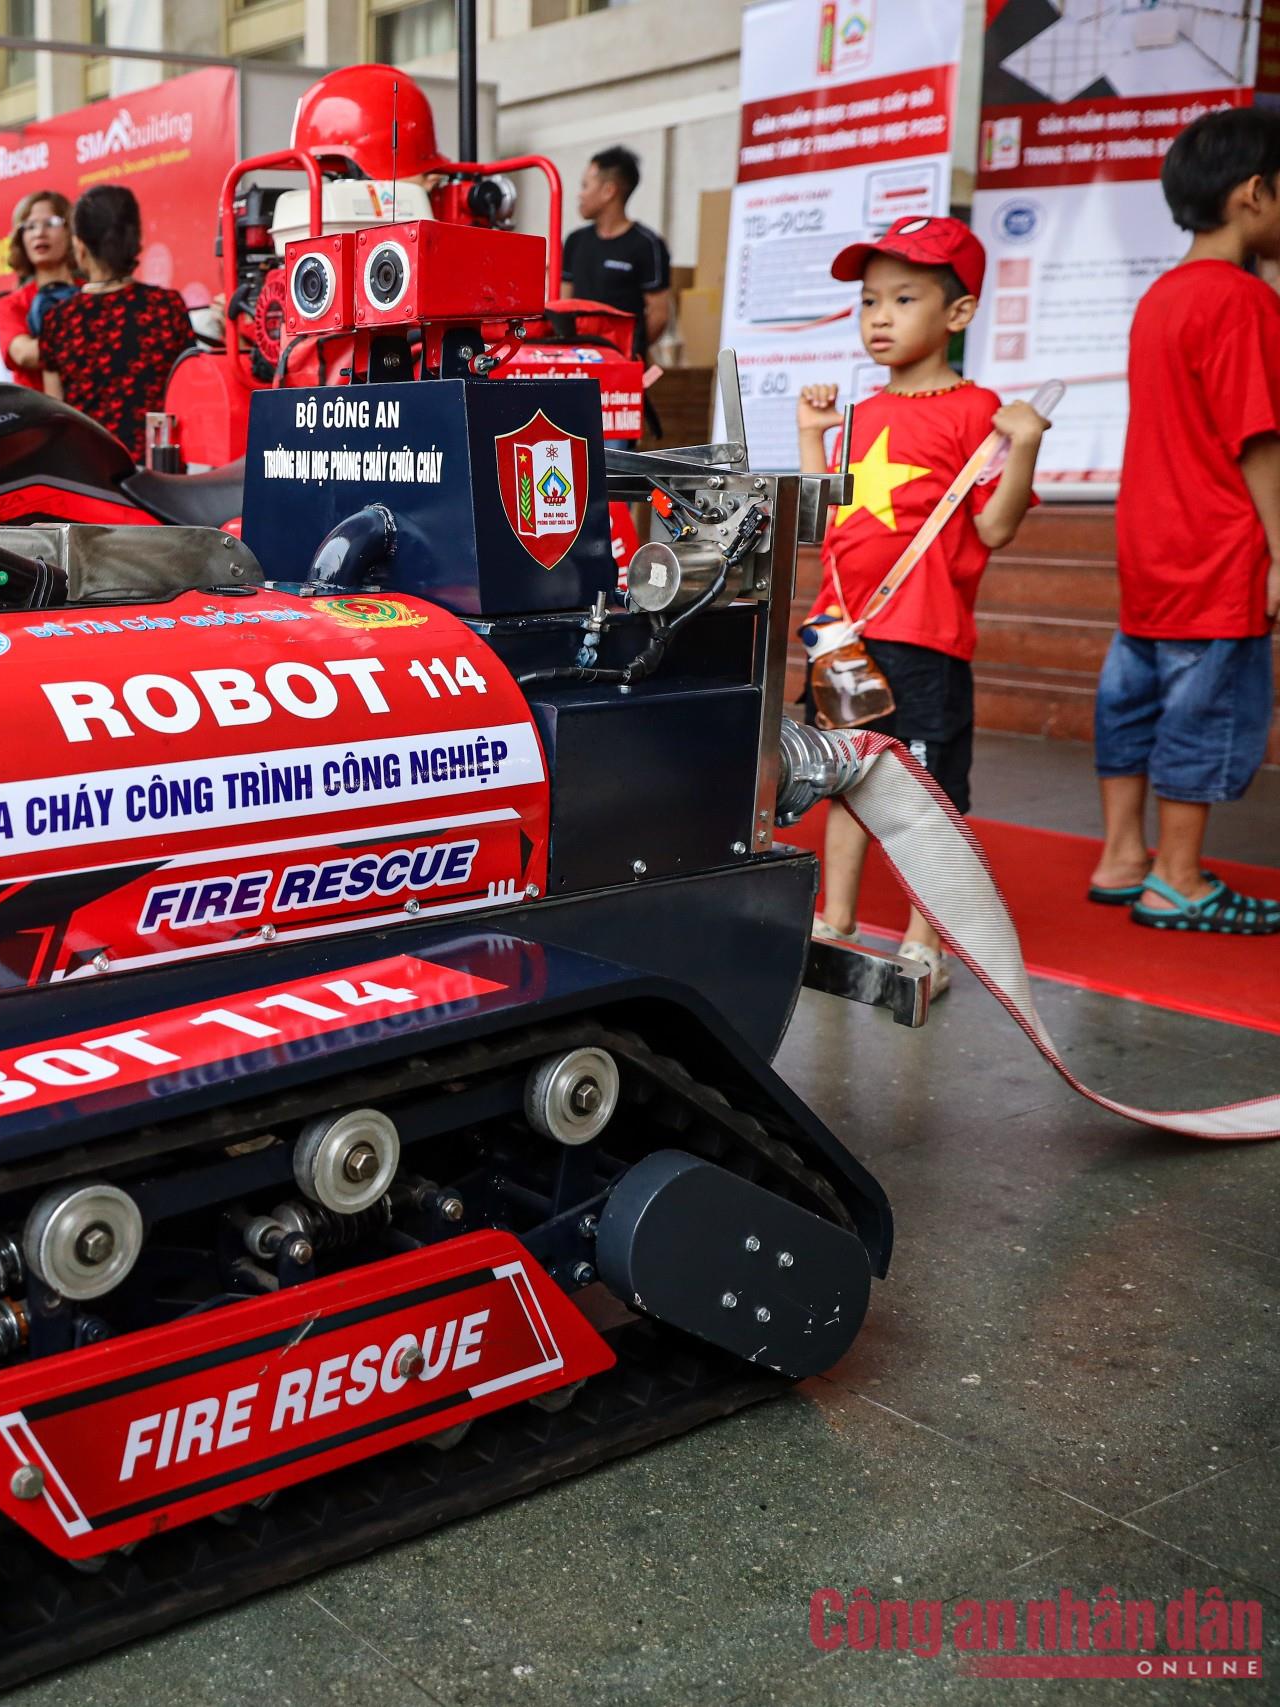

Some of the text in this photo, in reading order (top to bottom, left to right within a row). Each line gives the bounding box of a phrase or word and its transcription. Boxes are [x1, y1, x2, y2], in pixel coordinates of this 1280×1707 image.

[295, 396, 400, 433] BỘ CÔNG AN
[263, 443, 443, 486] TRƯỜNG ĐẠI HỌC PHÒNG CHÁY CHỮA CHÁY
[24, 622, 74, 638] ĐỀ
[72, 619, 123, 635] TÀI
[120, 615, 177, 632] CẤP
[259, 607, 312, 623] GIA
[40, 655, 488, 743] ROBOT 114
[25, 782, 114, 837] CHÁY
[126, 774, 214, 824] CÔNG
[222, 759, 314, 807] TRÌNH
[322, 751, 402, 799] CÔNG
[410, 736, 509, 785] NGHIỆP
[138, 840, 477, 934] FIRE RESCUE
[188, 977, 418, 1040] 114
[118, 1308, 491, 1482] FIRE RESCUE
